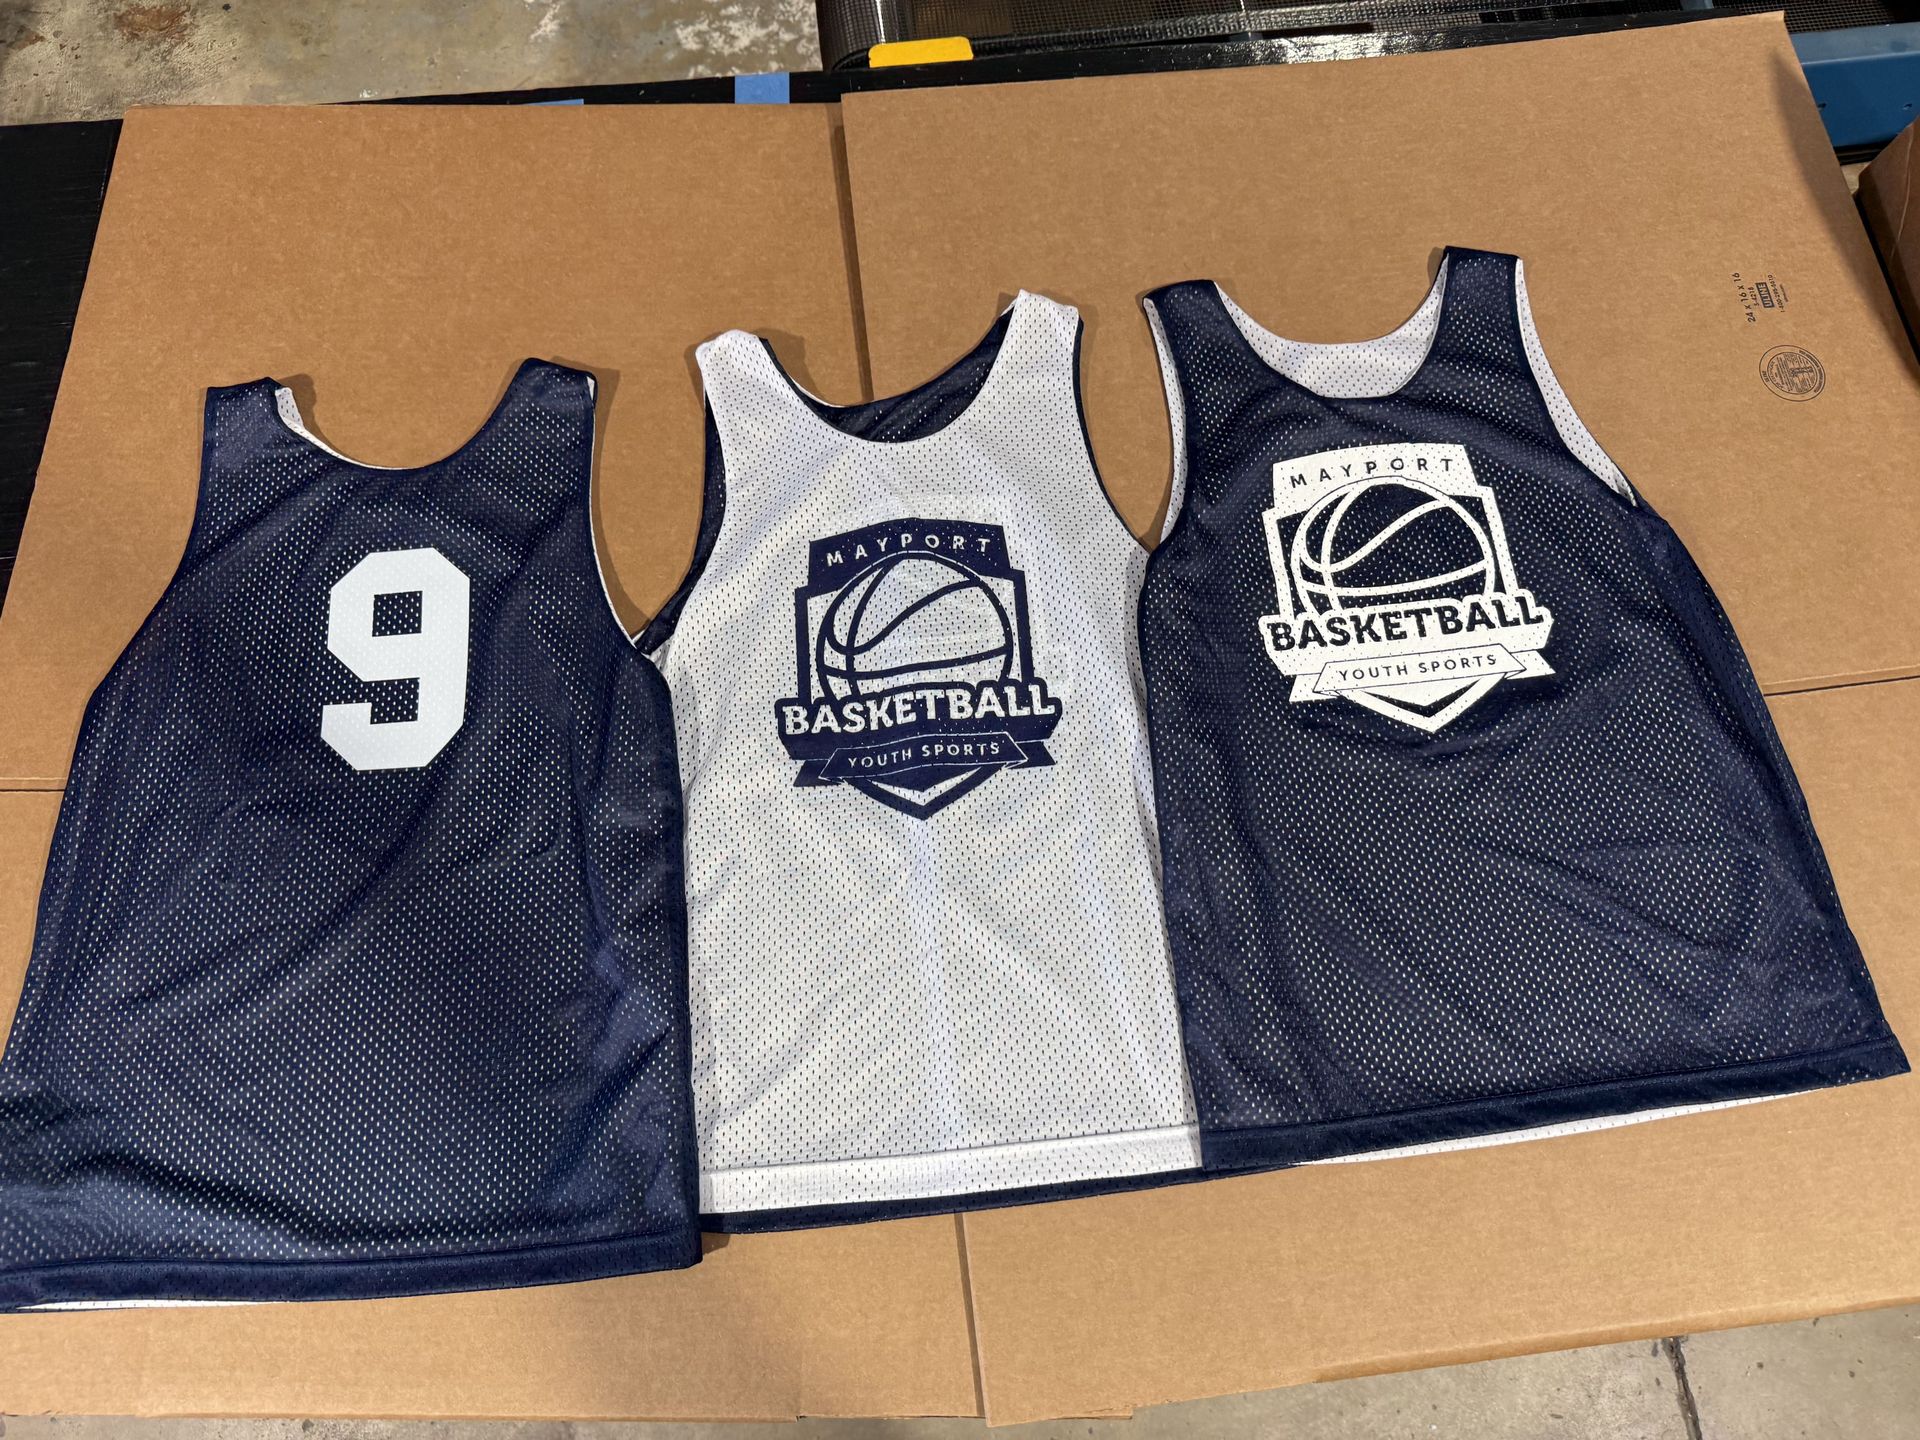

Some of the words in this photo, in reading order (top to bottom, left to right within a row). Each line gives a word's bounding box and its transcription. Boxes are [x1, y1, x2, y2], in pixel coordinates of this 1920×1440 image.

[1732, 272, 1741, 282] 16
[1738, 292, 1749, 302] 16
[1756, 283, 1773, 307] ULINE
[1745, 311, 1756, 322] 24
[1289, 457, 1454, 488] MAYPORT
[825, 533, 991, 566] MAYPORT
[1266, 595, 1544, 652] BASKETBALL
[320, 547, 470, 771] 9
[1338, 664, 1409, 681] YOUTH
[1418, 653, 1497, 674] SPORTS
[782, 683, 1056, 736] BASKETBALL
[847, 749, 912, 768] YOUTH
[921, 741, 1000, 757] SPORTS
